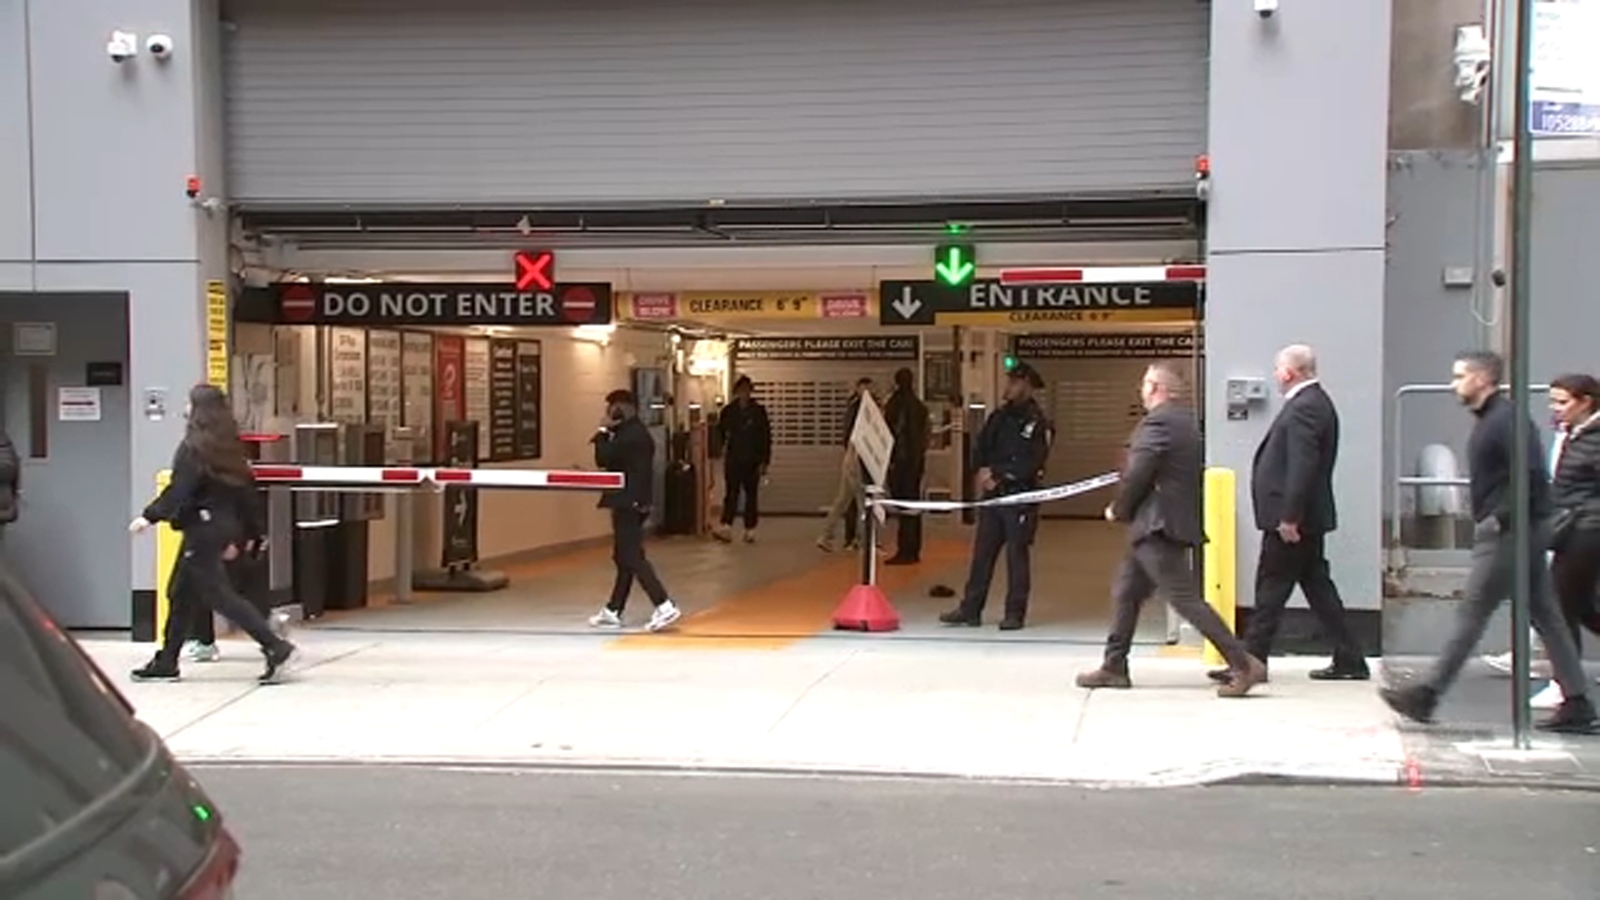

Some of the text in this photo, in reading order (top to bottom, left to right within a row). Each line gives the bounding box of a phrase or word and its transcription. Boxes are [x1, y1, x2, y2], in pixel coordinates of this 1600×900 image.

[968, 282, 1152, 307] ENTRANCE
[323, 292, 556, 317] DO NOT ENTER
[689, 297, 764, 313] CLEARANCE
[1009, 311, 1083, 322] CLEARANCE
[738, 338, 802, 350] PASSENGERS
[804, 338, 841, 350] PLEASE
[842, 338, 865, 349] EXIT
[867, 339, 887, 349] THE
[1018, 337, 1086, 347] PASSENGERS
[1087, 337, 1127, 347] PLEASE
[1128, 337, 1152, 346] EXIT
[1154, 337, 1175, 346] THE
